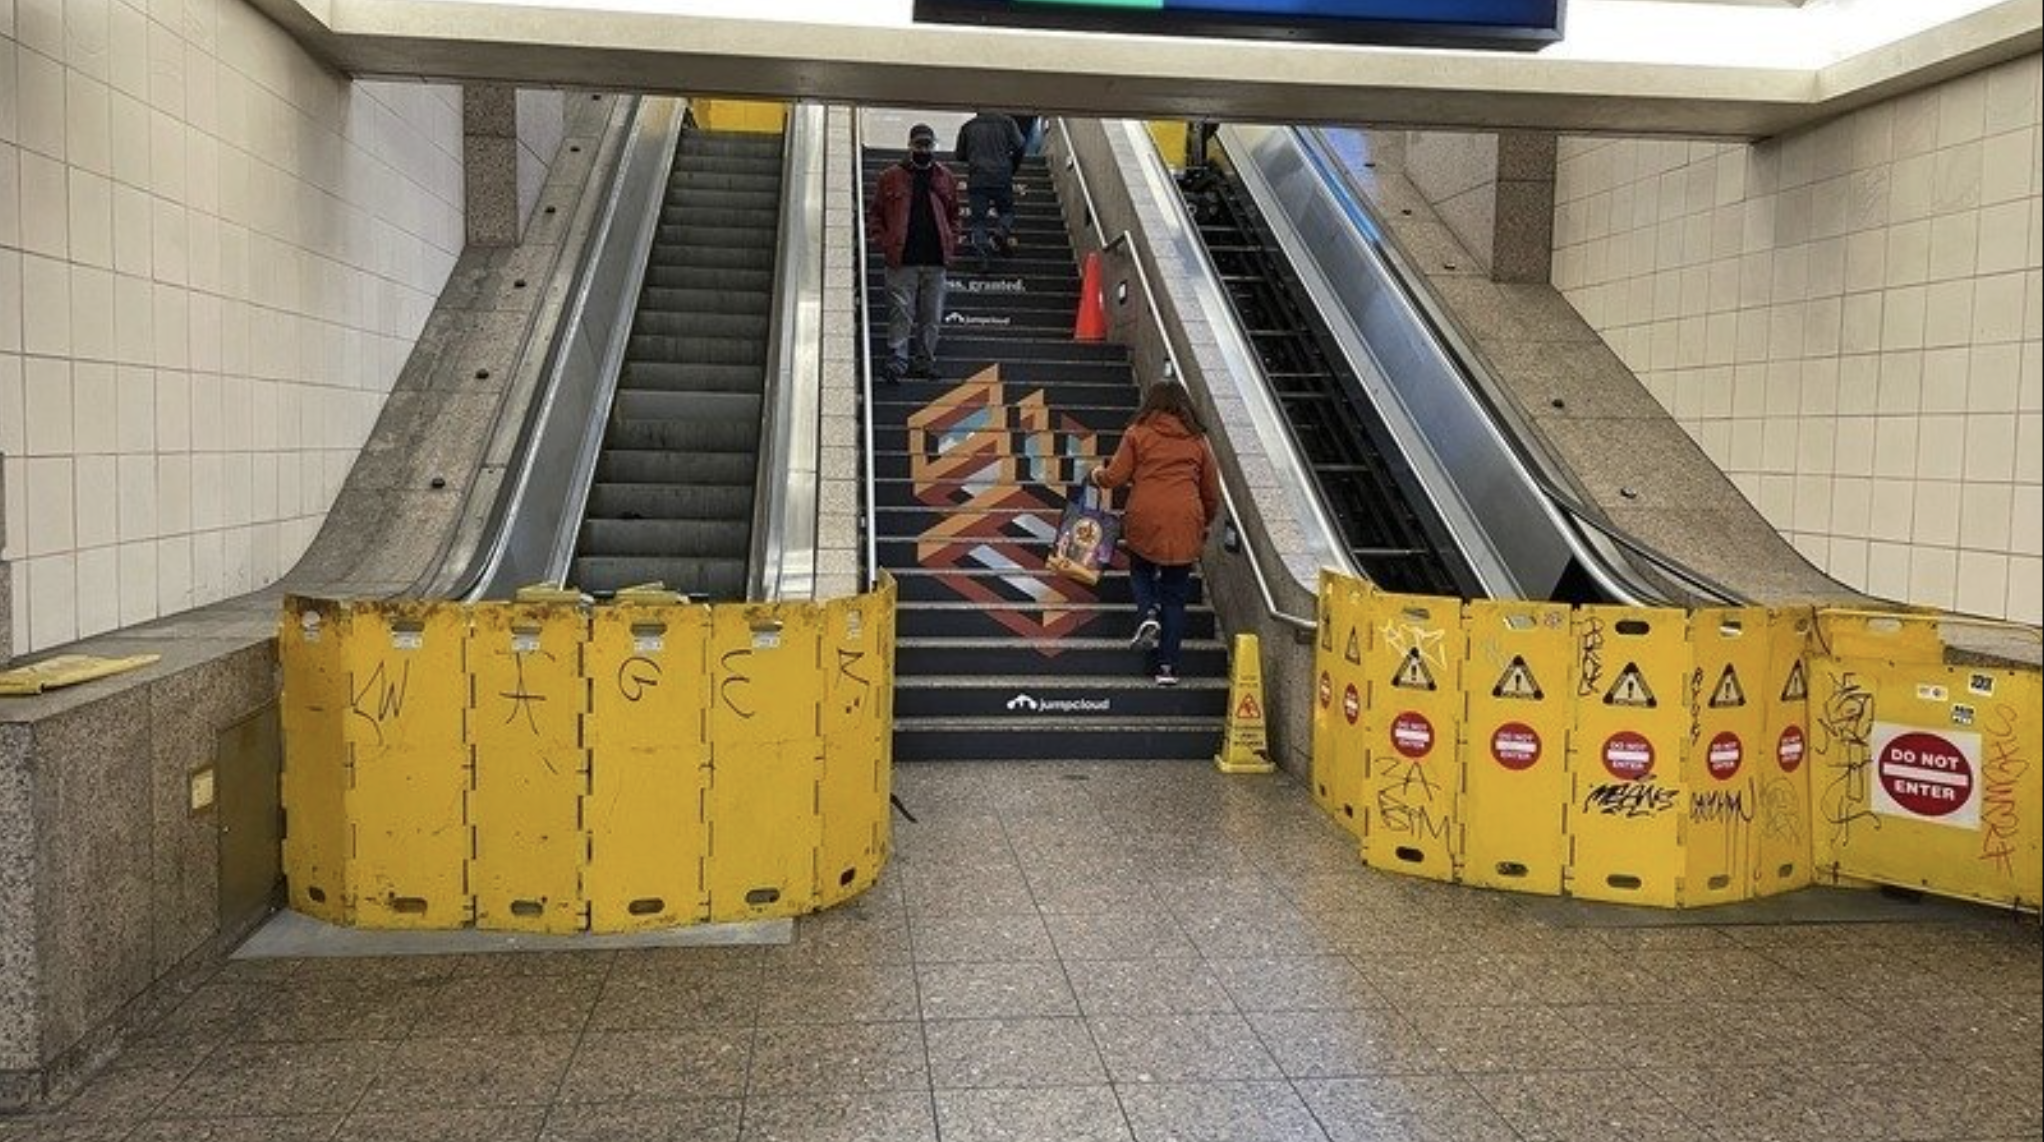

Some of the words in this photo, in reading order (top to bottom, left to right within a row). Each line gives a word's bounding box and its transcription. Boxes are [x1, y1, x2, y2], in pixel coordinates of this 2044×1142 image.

[1038, 698, 1110, 712] jumpcloud
[1891, 748, 1917, 763] DO
[1921, 752, 1960, 771] NOT
[1893, 780, 1956, 801] ENTER
